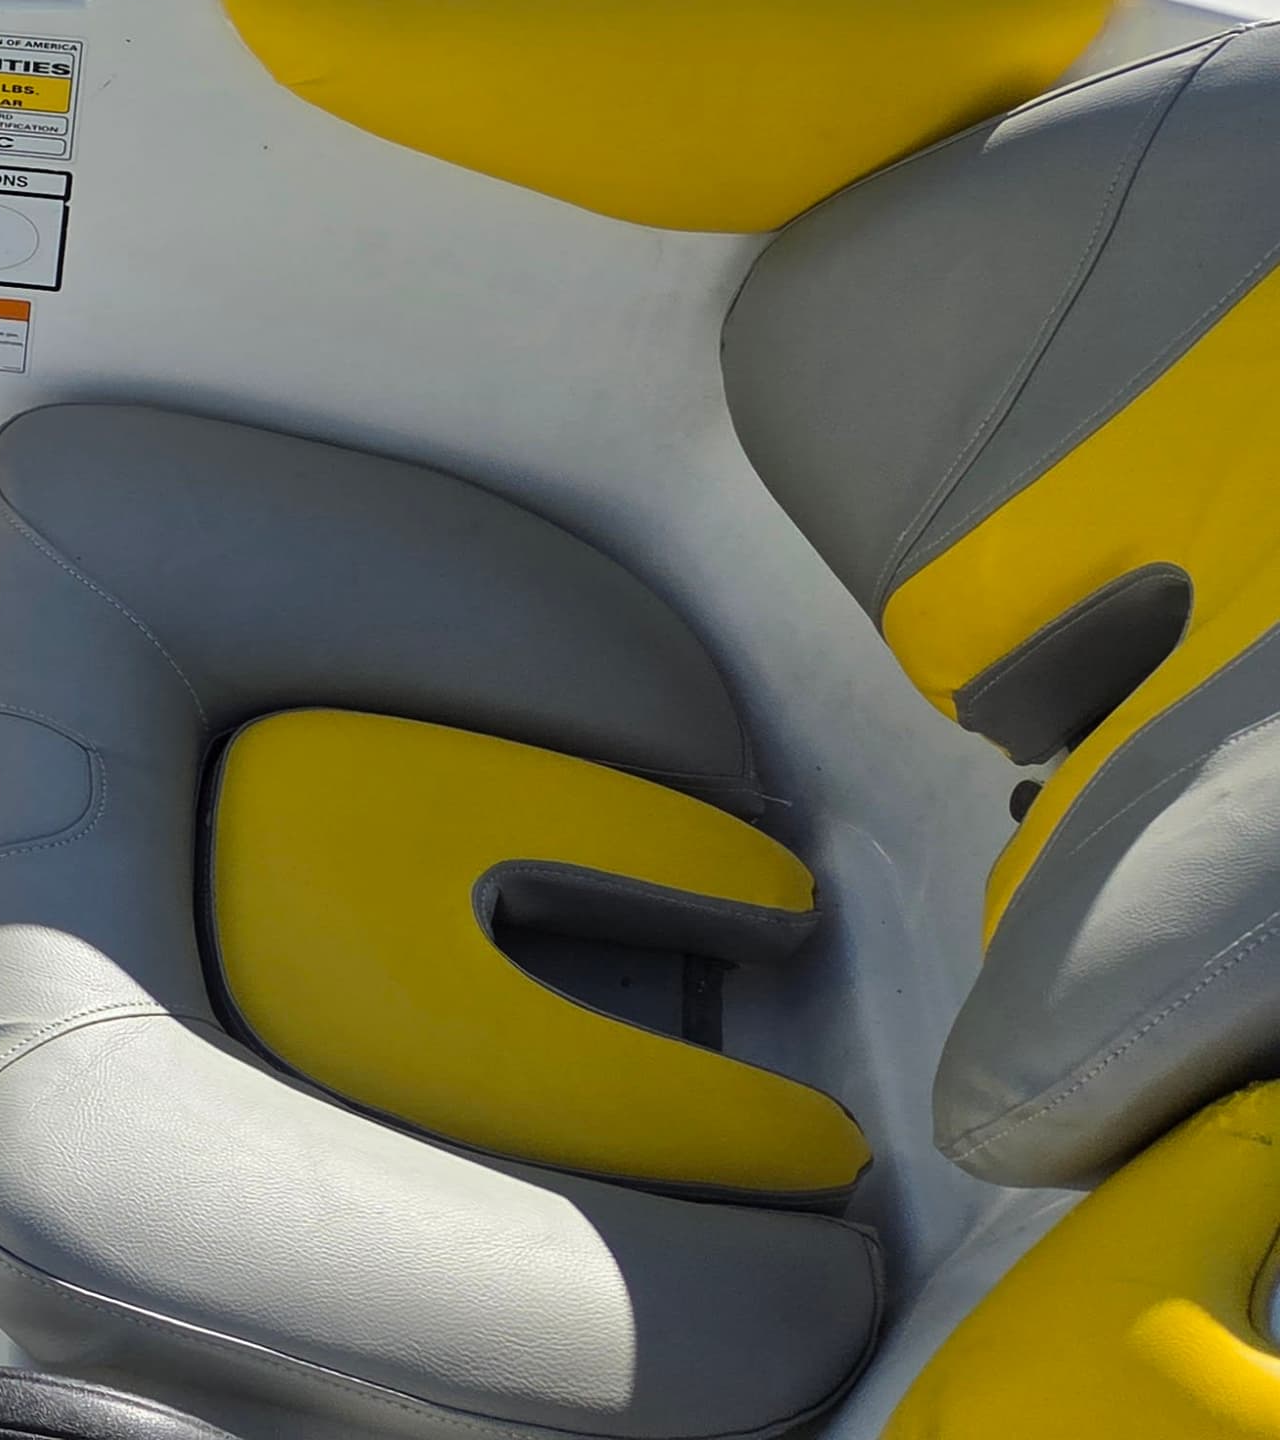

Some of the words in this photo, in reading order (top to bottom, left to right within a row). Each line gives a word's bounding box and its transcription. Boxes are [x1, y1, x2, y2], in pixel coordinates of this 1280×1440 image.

[6, 39, 21, 47] OF
[25, 41, 78, 52] AMERICA
[2, 83, 40, 96] LBS.
